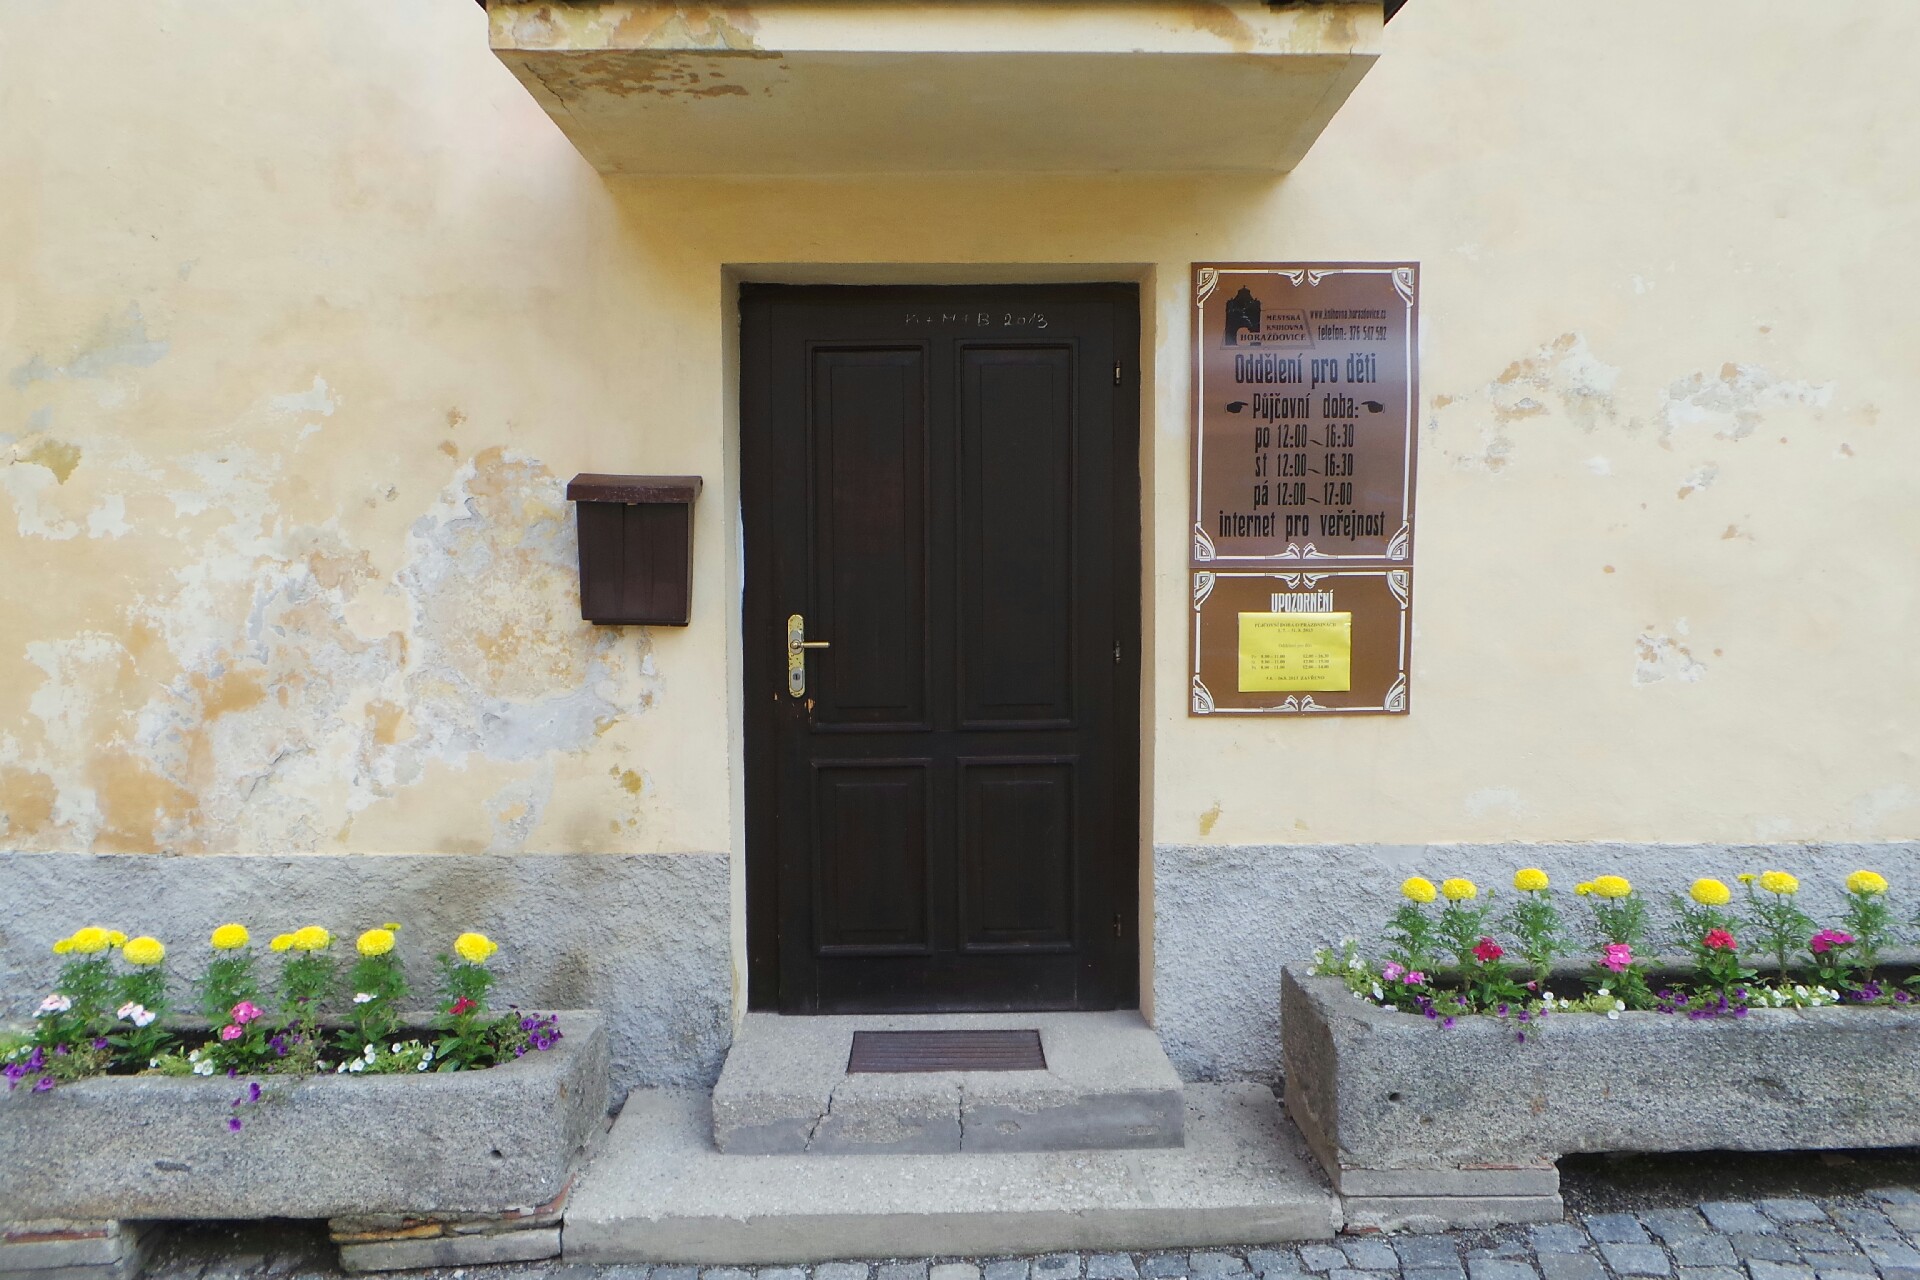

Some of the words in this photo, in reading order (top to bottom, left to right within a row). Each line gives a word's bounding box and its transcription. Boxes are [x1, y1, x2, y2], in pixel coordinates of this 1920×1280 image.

[1318, 324, 1347, 340] telefon:
[1349, 325, 1361, 341] 376
[1234, 353, 1303, 384] Oddělení
[1311, 358, 1338, 389] pro
[1346, 353, 1376, 383] děti
[1252, 392, 1310, 424] Půjčovní
[1322, 393, 1359, 419] doba:
[1255, 426, 1270, 453] po
[1277, 424, 1307, 448] 12:00
[1325, 423, 1354, 448] 16:30
[1255, 453, 1267, 477] st
[1277, 453, 1307, 477] 12:00
[1324, 453, 1353, 476] 16:30
[1253, 480, 1269, 510] pá
[1277, 482, 1306, 506] 12:00
[1324, 482, 1353, 506] 17:00
[1219, 510, 1275, 537] internet
[1285, 514, 1309, 542] pro
[1320, 509, 1385, 541] veřejnost
[1271, 589, 1334, 613] UPOZORNĚNÍ
